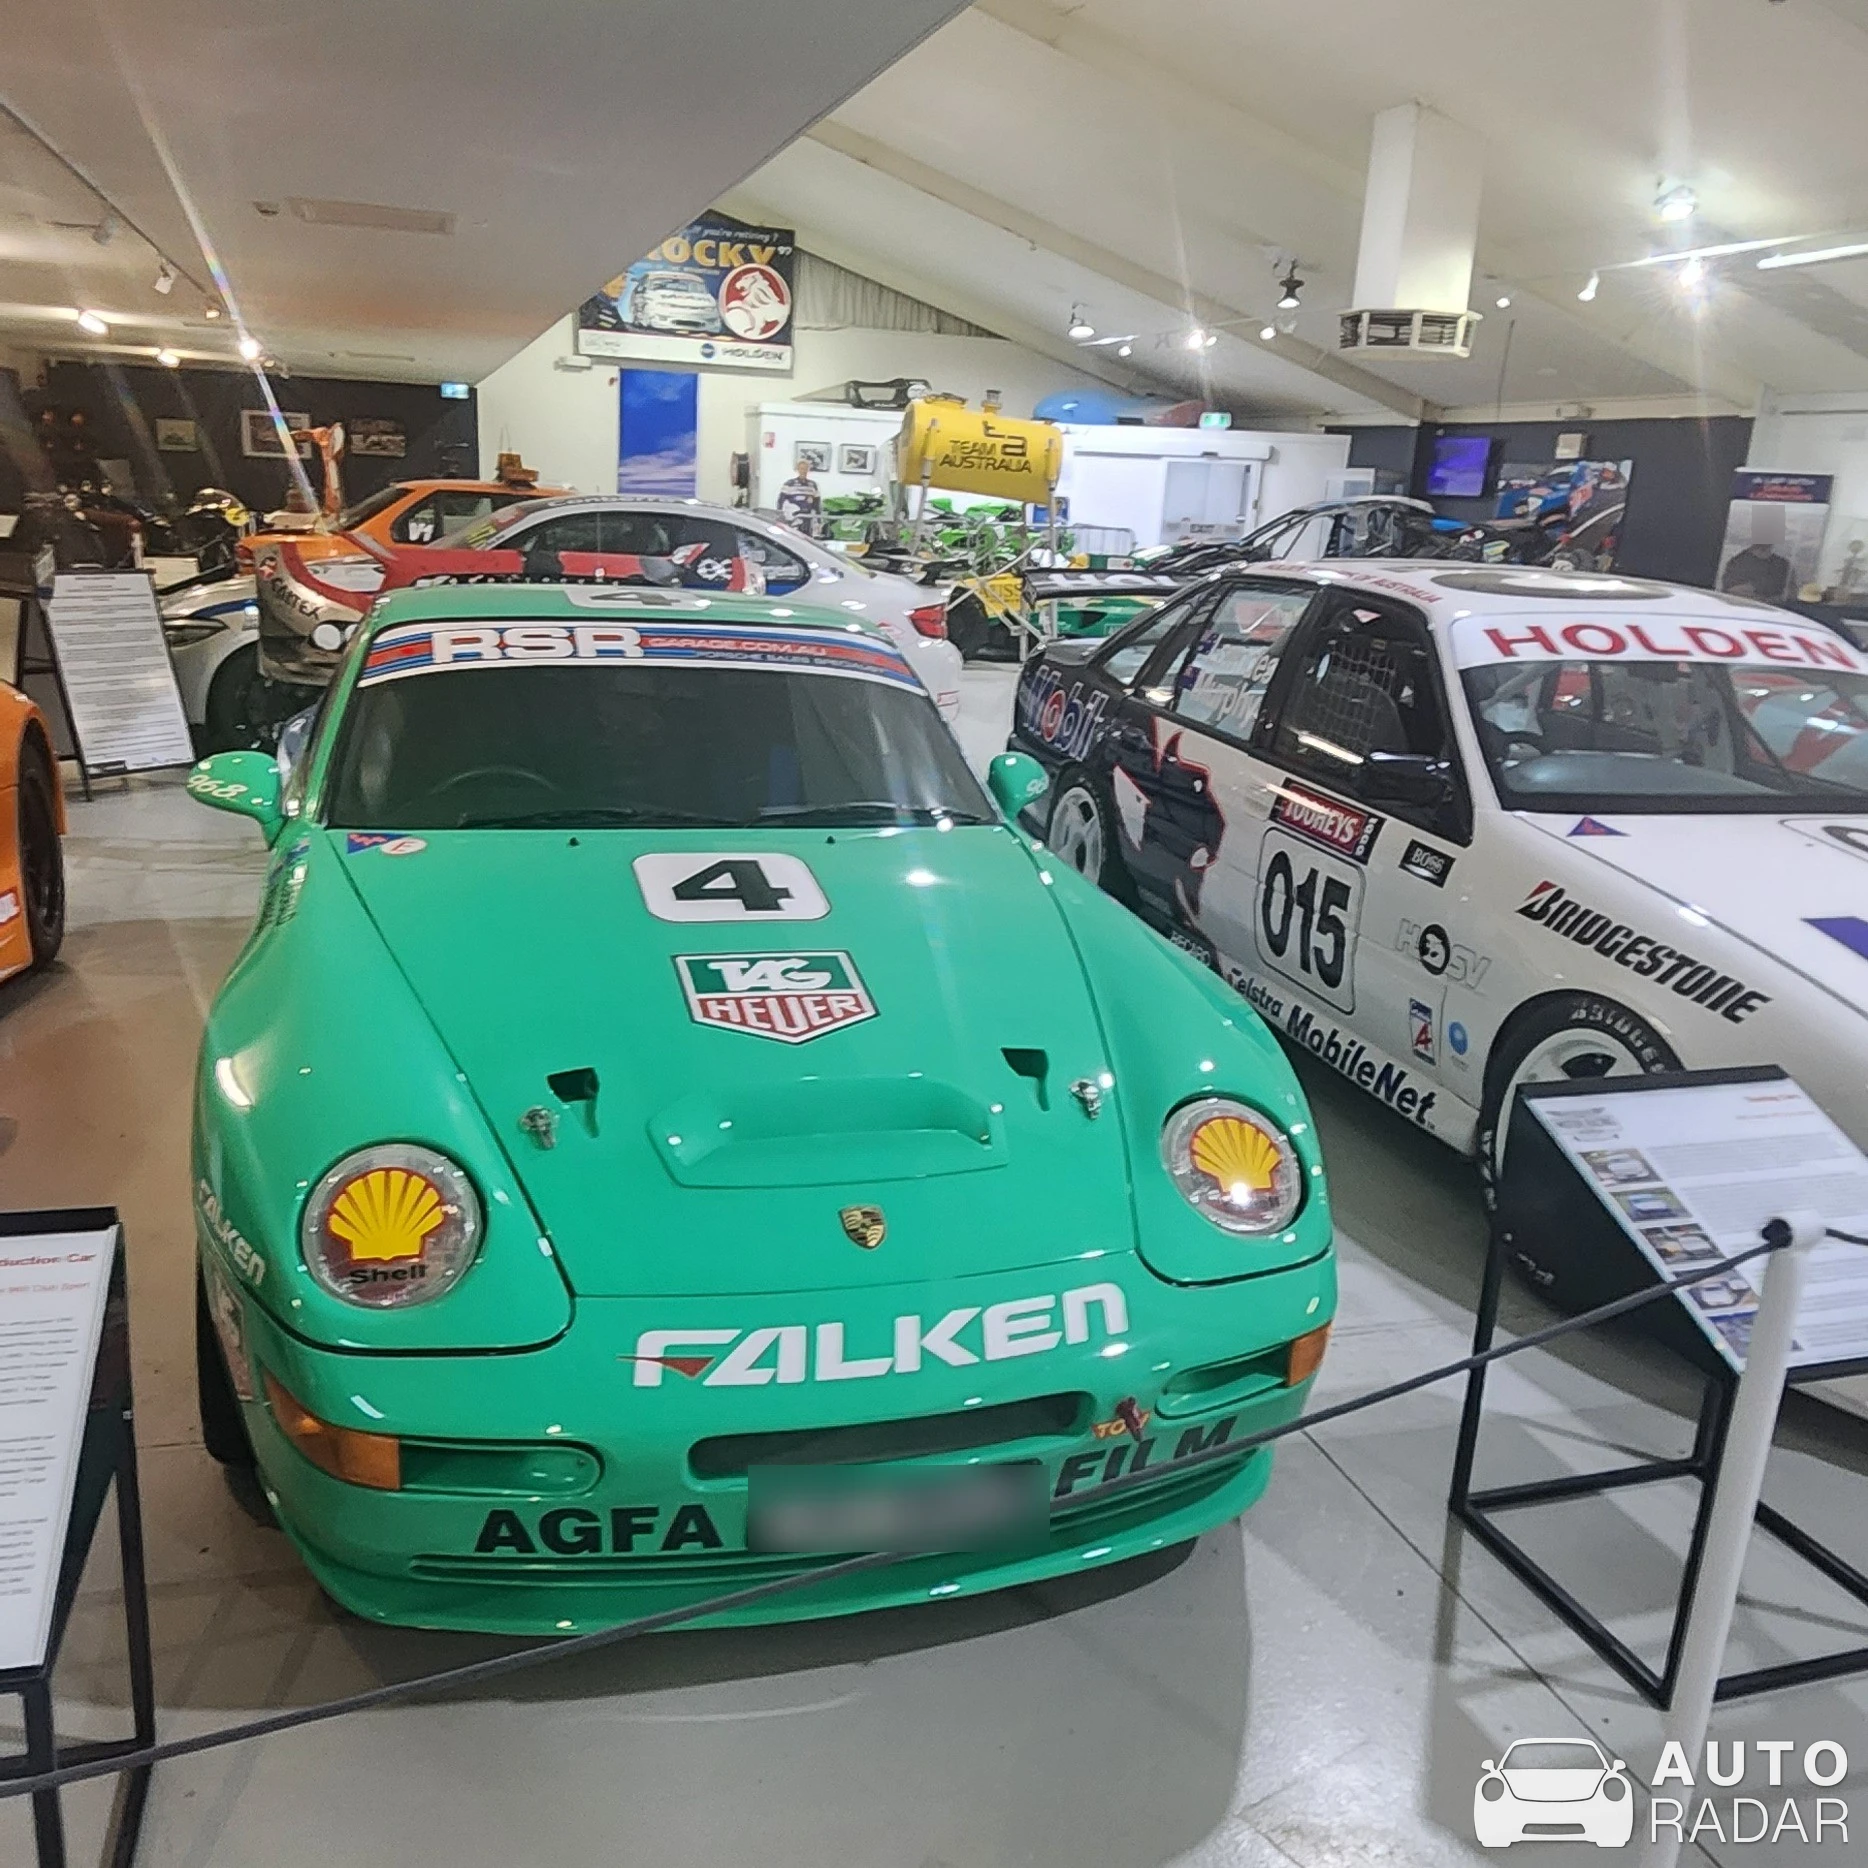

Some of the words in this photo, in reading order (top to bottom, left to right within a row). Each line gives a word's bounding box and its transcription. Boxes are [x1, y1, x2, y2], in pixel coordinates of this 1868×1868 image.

[939, 455, 1032, 474] AUSTRALIA
[949, 440, 997, 456] TEAM
[431, 625, 645, 663] RSR
[1484, 624, 1858, 669] HOLDEN
[1024, 664, 1109, 762] Mobil
[672, 859, 796, 912] 4
[1261, 850, 1351, 989] 015
[707, 959, 833, 992] TAG
[1515, 879, 1774, 1025] BRIDGESTONE
[706, 997, 866, 1034] HEUER
[1286, 1004, 1437, 1125] MobileNet
[350, 1263, 429, 1285] Shell
[617, 1282, 1129, 1388] FALKEN
[1053, 1415, 1238, 1498] FILM
[474, 1504, 724, 1555] AGFA
